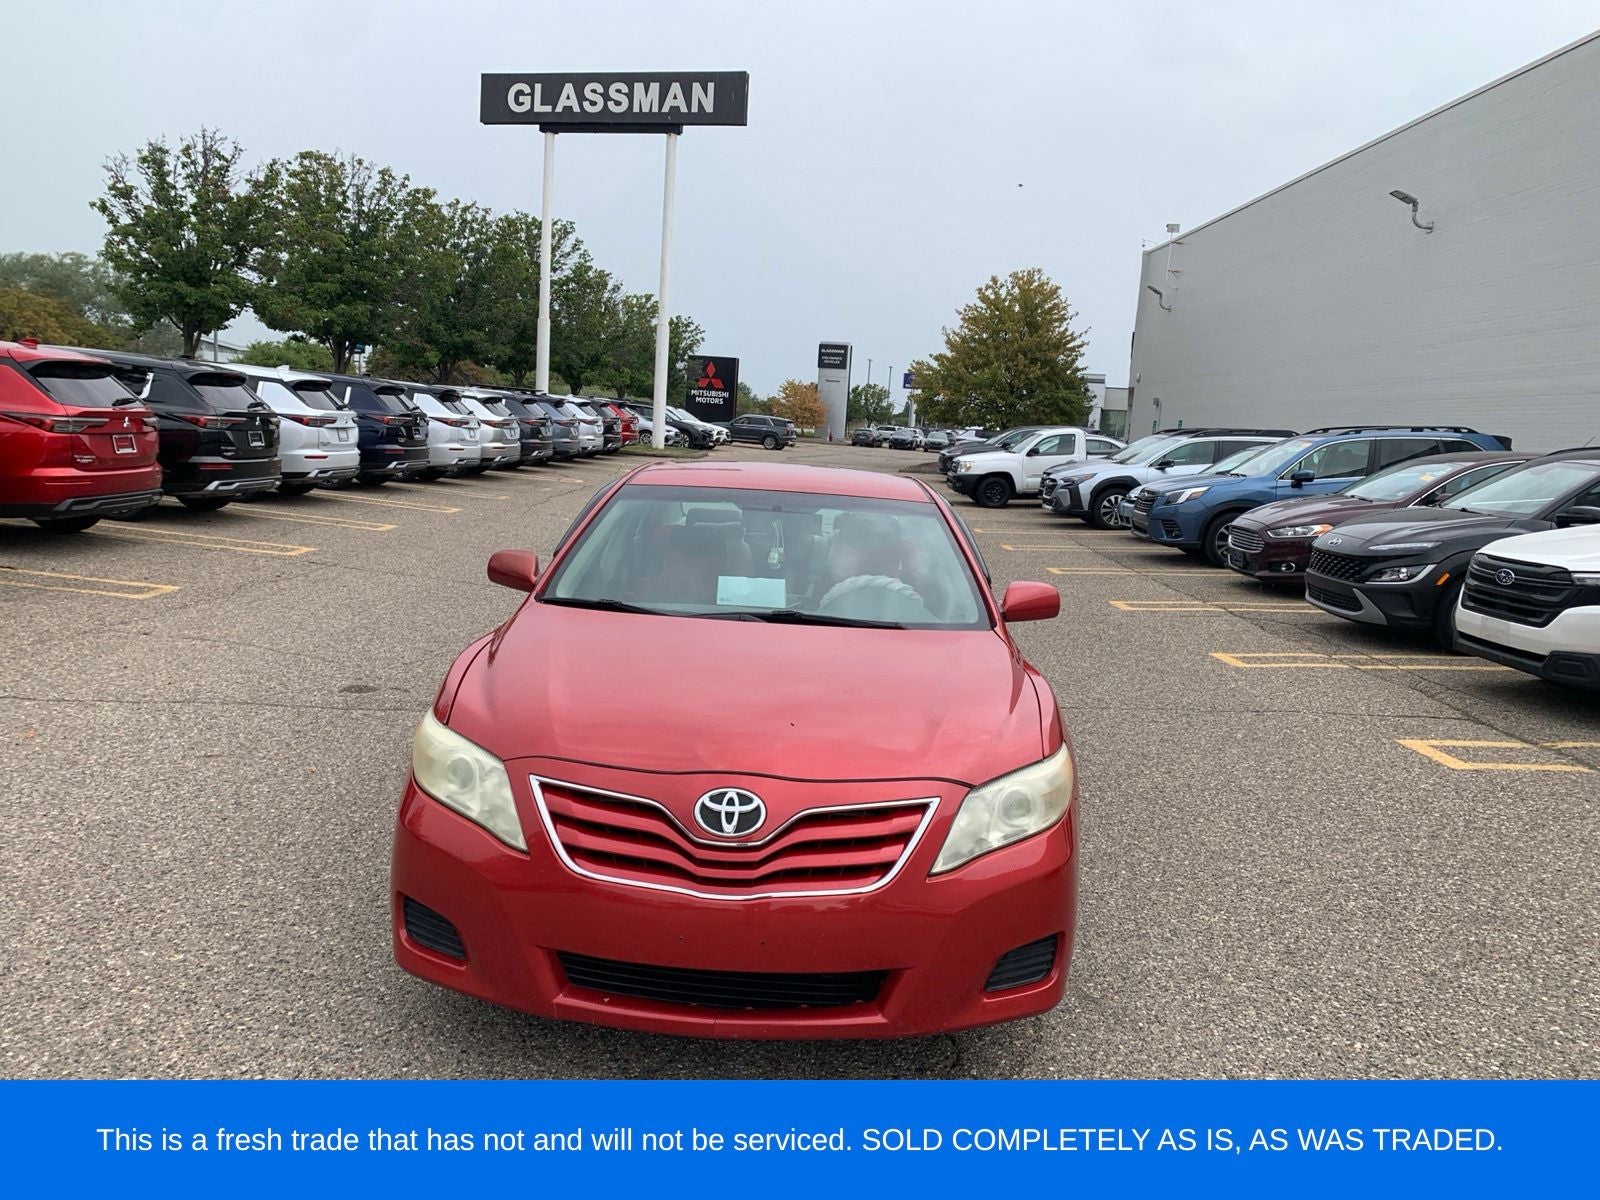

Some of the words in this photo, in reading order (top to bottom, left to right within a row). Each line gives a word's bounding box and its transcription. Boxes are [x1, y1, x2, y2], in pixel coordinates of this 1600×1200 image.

[507, 81, 715, 114] GLASSMAN
[691, 389, 729, 398] MITSUBISHI
[695, 397, 724, 405] MOTORS
